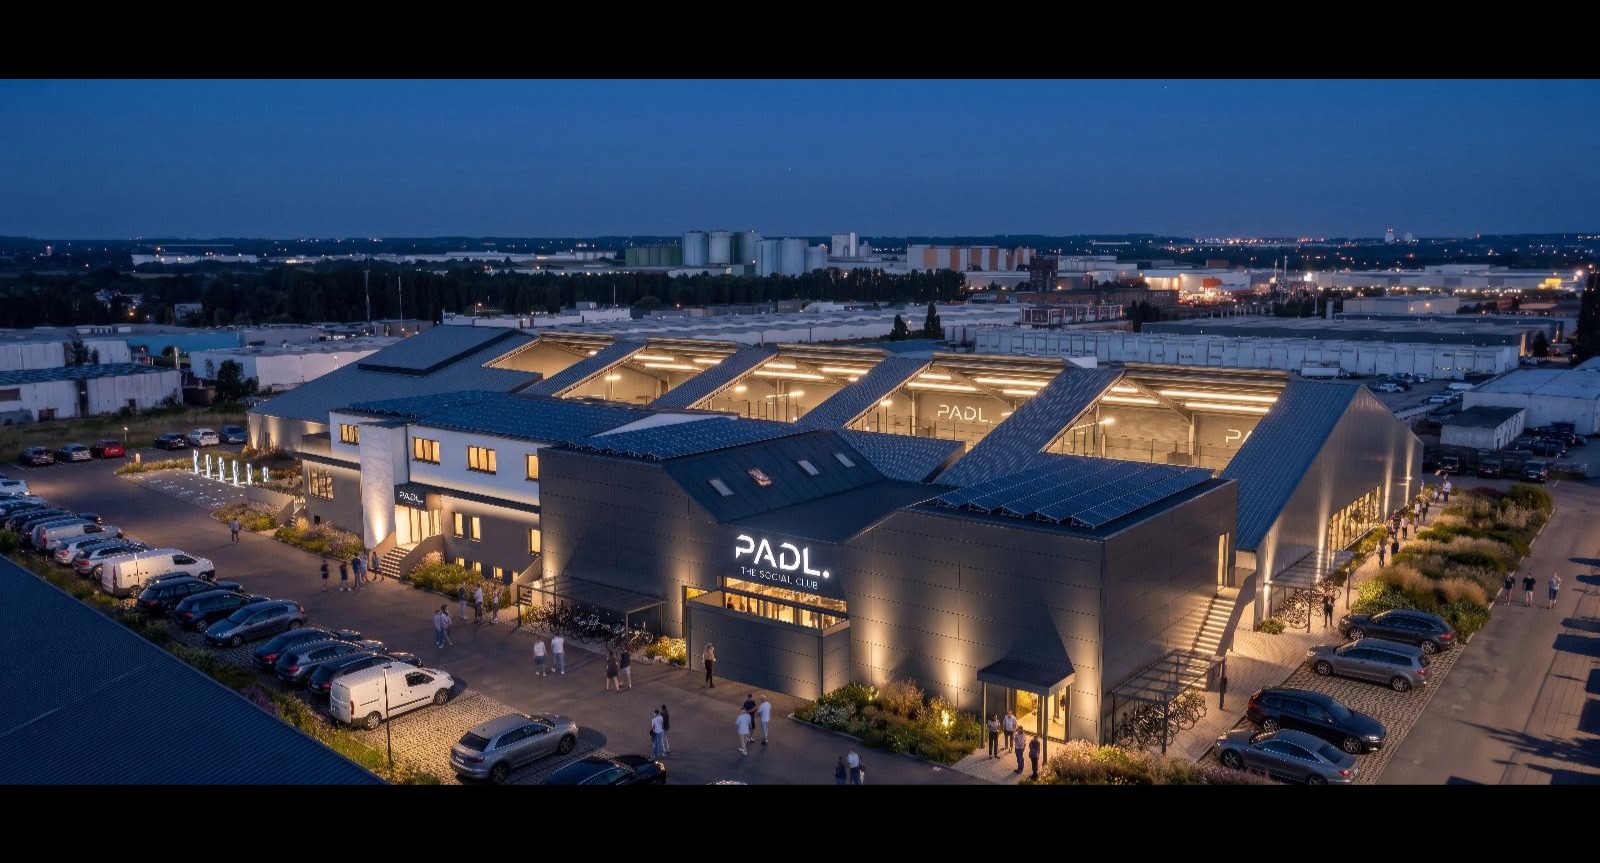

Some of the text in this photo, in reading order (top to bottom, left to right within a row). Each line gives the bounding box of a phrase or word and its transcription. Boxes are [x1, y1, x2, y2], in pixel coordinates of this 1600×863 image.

[735, 534, 830, 579] PADL.
[740, 566, 818, 590] THE SOCIAL CLUB
